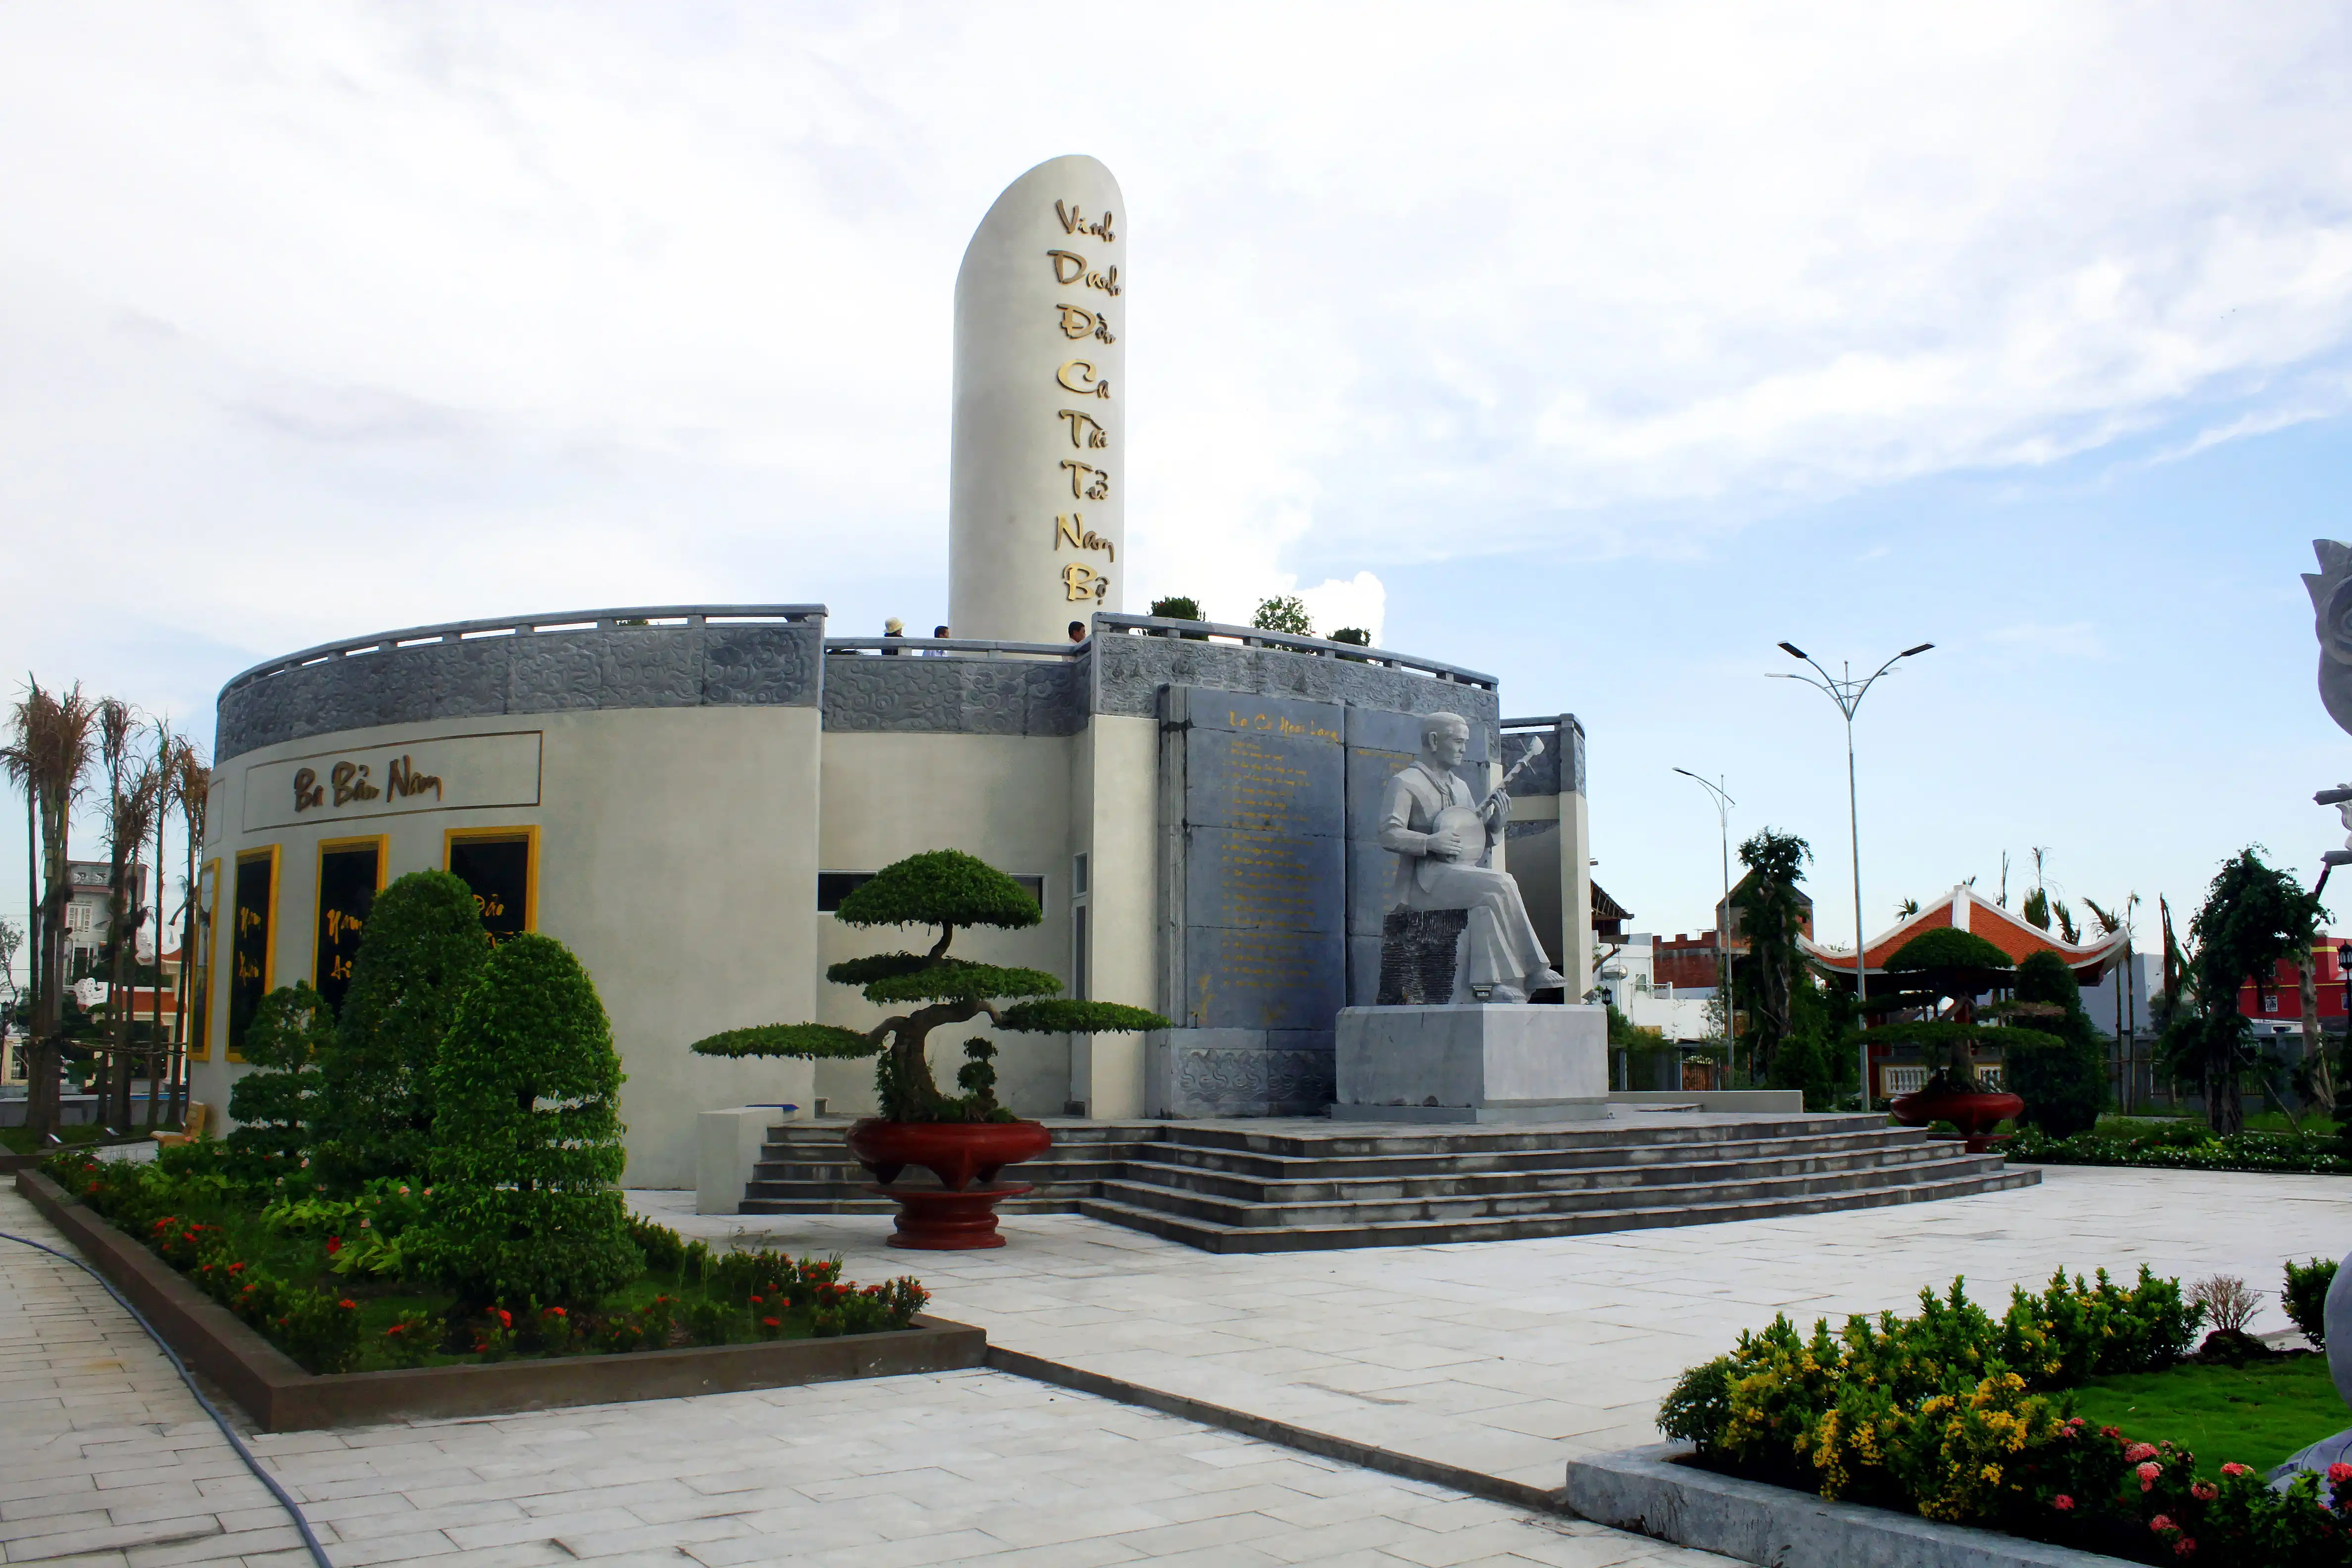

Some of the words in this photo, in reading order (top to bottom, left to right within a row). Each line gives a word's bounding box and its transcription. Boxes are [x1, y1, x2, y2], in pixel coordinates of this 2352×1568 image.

[1046, 249, 1122, 296] Danh
[1057, 358, 1111, 399] Ca
[1054, 513, 1115, 563] Nam
[1062, 562, 1110, 605] Bộ
[386, 755, 442, 803] Nam
